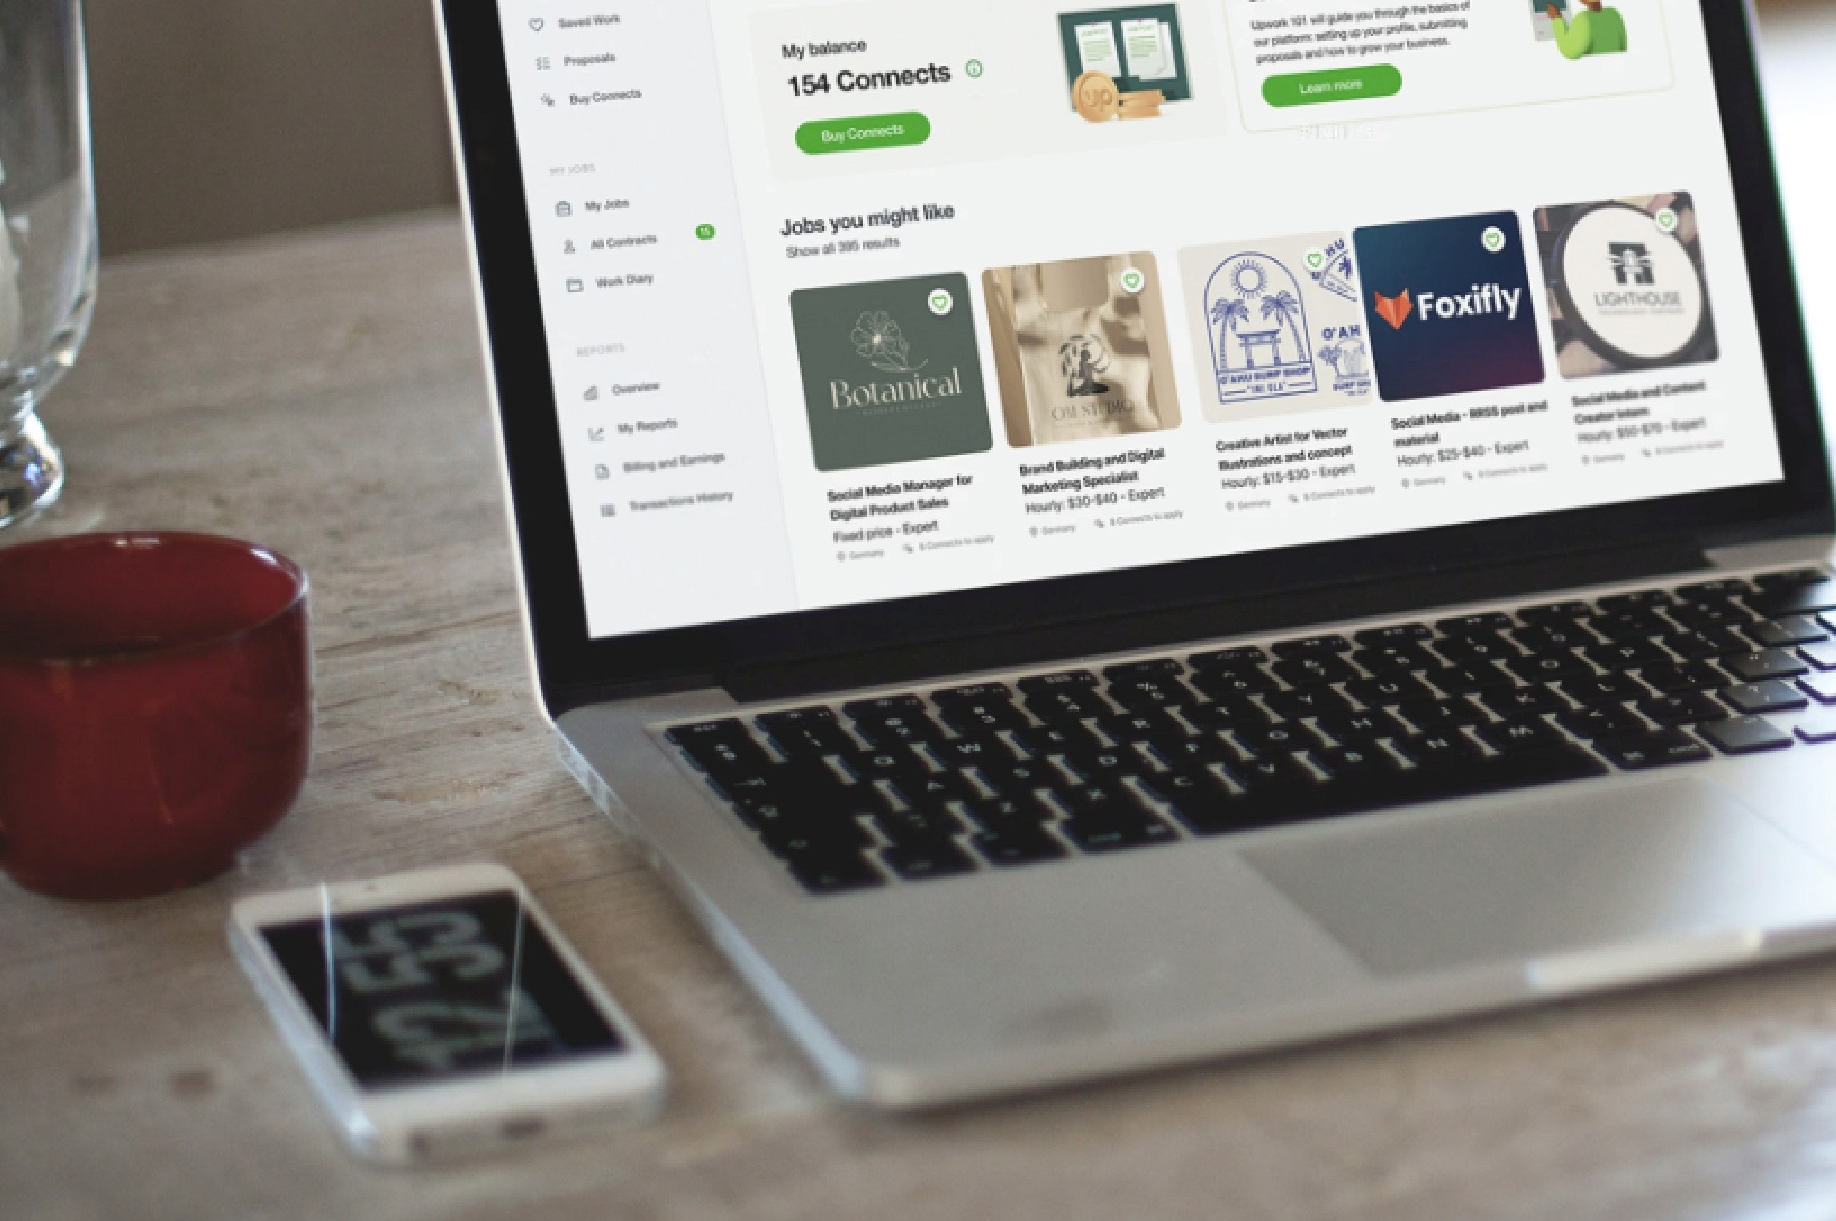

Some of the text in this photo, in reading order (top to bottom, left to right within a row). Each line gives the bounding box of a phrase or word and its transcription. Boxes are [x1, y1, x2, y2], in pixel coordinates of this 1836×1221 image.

[559, 15, 620, 29] Saved Work
[1251, 18, 1288, 31] Upwork
[564, 52, 615, 66] Proposals
[782, 41, 867, 61] My balance
[788, 63, 950, 96] 154 Connects
[1299, 79, 1362, 94] Learn more
[570, 89, 642, 105] Buy Connects
[822, 125, 905, 144] Buy Connects
[782, 205, 955, 235] Jobs you might like
[786, 244, 820, 258] Show
[863, 237, 901, 250] results
[1417, 283, 1519, 320] Foxifly
[1593, 290, 1681, 310] LIGHTHOUSE
[831, 368, 962, 409] Botanical
[1571, 382, 1706, 407] Social Media and Content
[1391, 416, 1426, 430] Social
[1425, 412, 1461, 425] Media
[1501, 403, 1527, 417] post
[1526, 400, 1548, 412] and
[1575, 412, 1615, 425] Creator
[1671, 418, 1706, 432] Expert
[1216, 428, 1346, 453] Creative Artist for Vector
[1393, 432, 1439, 447] material
[1020, 448, 1164, 476] Brand Building and Digital
[1218, 446, 1353, 471] Illustrations and concept
[1398, 453, 1436, 467] Hourly:
[1495, 441, 1528, 455] Expert
[1022, 471, 1139, 494] Marketing Specialist
[1222, 476, 1261, 489] Hourly:
[1319, 464, 1355, 478] Expert
[827, 476, 973, 503] Social Media Manager for
[831, 499, 948, 521] Digital Product Sales
[1025, 501, 1063, 515] Hourly:
[1128, 487, 1164, 501] Expert
[833, 521, 938, 542] Fixed price Expert
